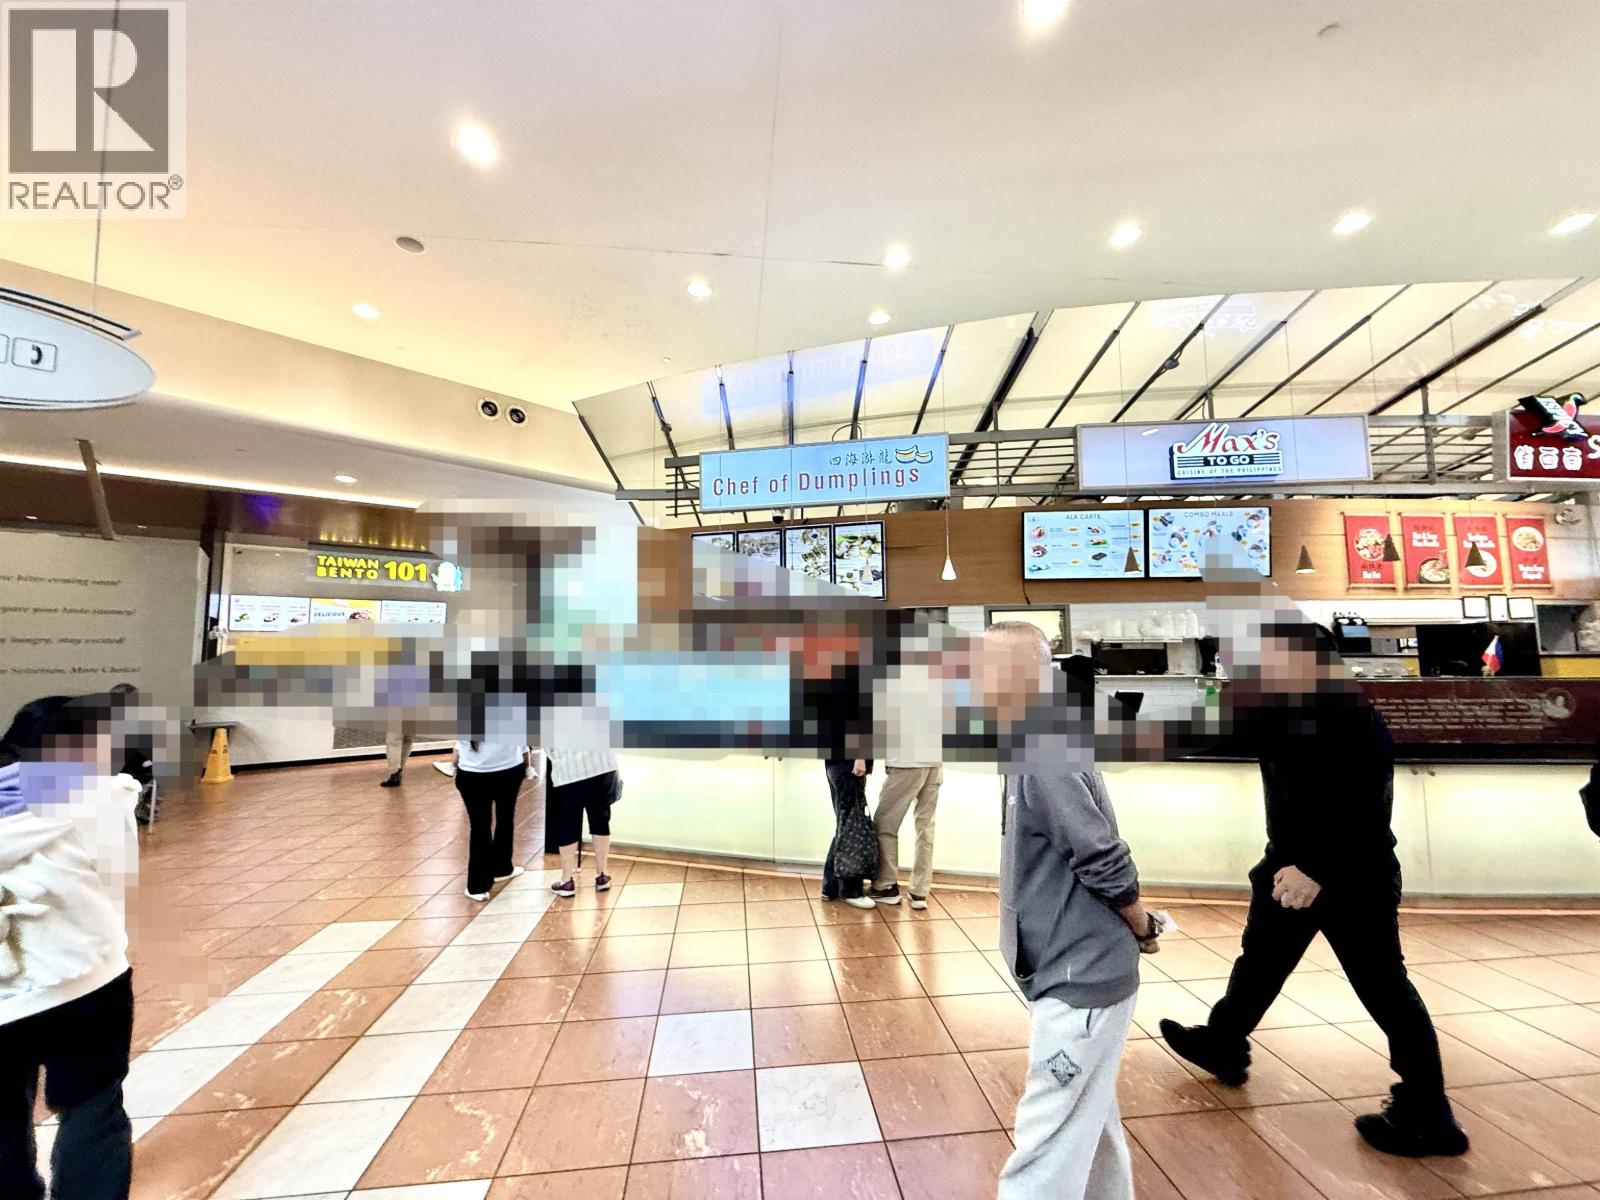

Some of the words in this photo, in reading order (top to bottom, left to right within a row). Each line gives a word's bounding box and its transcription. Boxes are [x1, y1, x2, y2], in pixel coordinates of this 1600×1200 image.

[1176, 422, 1280, 454] Max's
[1207, 456, 1228, 466] TO
[1229, 455, 1250, 465] GO
[713, 476, 759, 497] Chef
[769, 475, 788, 493] of
[799, 466, 920, 491] Dumplings
[316, 555, 380, 569] TAIWAN
[384, 560, 428, 582] 101
[316, 567, 379, 580] BENTO
